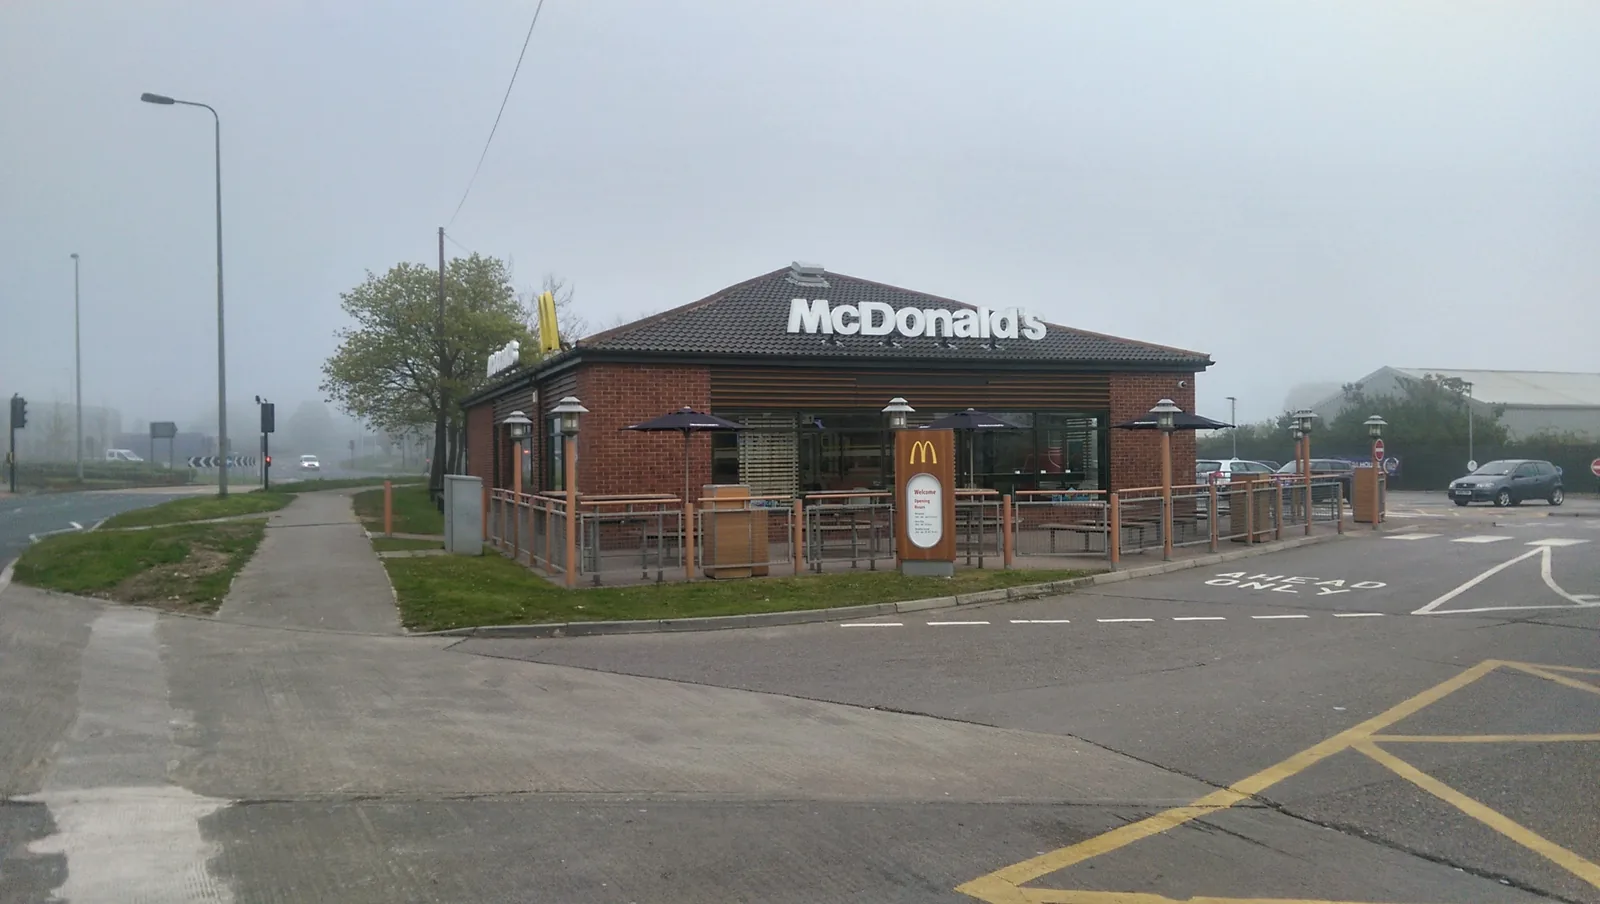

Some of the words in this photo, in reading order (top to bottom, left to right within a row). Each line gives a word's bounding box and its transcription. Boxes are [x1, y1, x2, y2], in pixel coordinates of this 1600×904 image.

[786, 298, 1048, 341] McDonald's
[1204, 578, 1351, 596] ONLY
[1215, 571, 1387, 589] AHEAD
